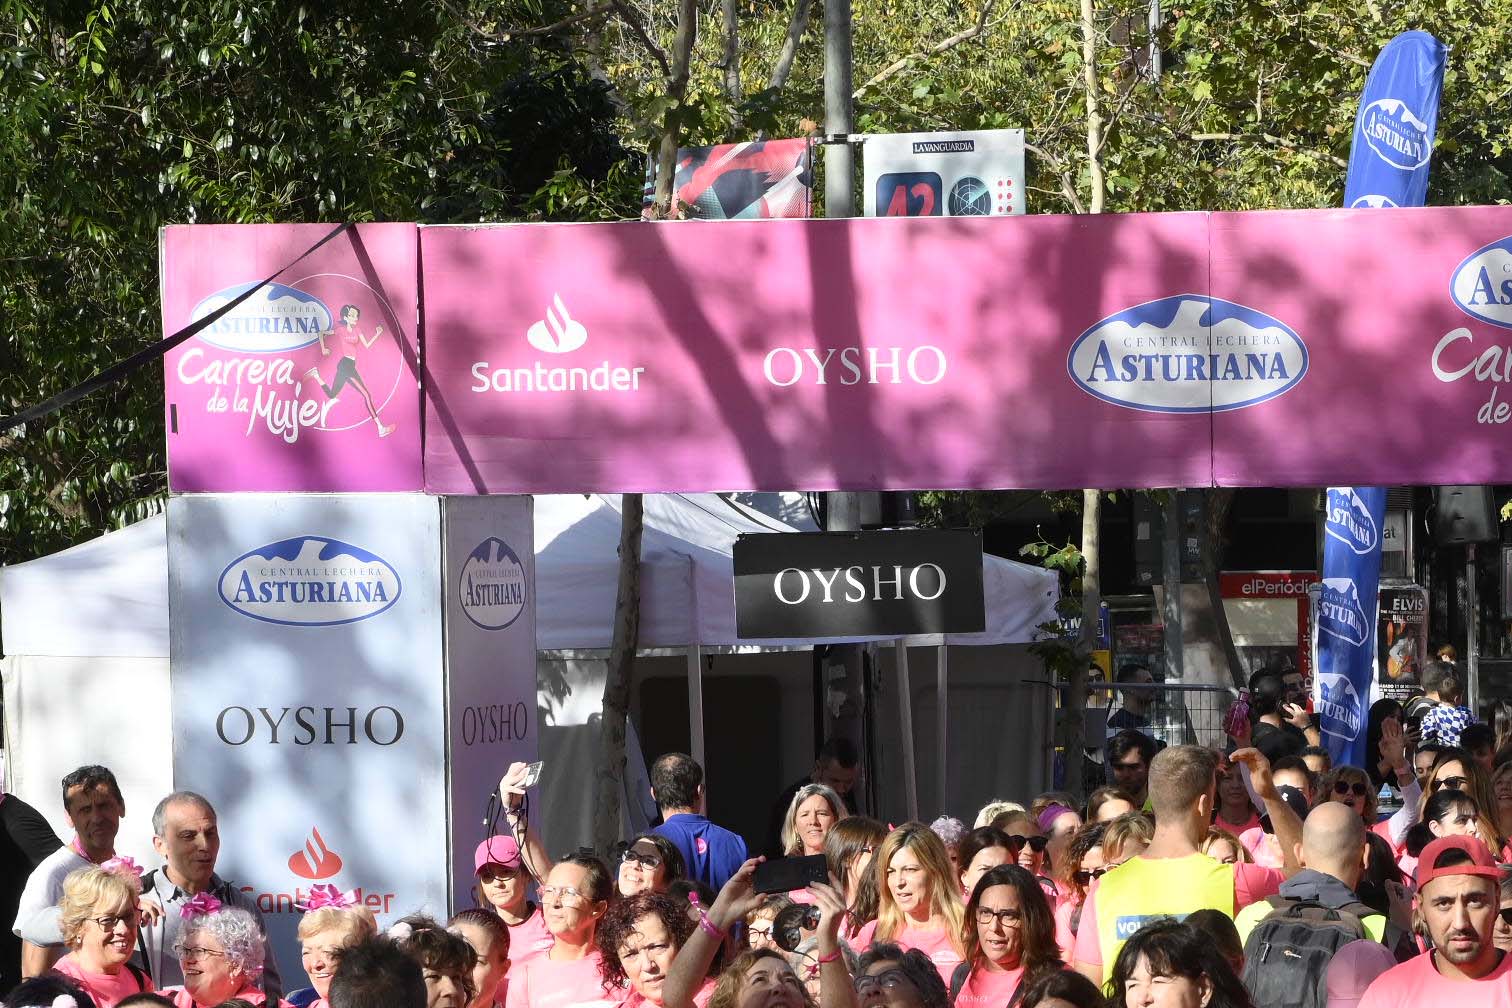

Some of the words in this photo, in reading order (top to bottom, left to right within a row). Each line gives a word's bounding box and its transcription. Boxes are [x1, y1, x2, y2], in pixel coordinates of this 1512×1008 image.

[1122, 335, 1199, 348] CENTRAL
[1205, 334, 1281, 346] LECHERA
[177, 346, 296, 385] Carrera
[471, 361, 645, 393] Santander
[762, 345, 947, 387] OYSHO
[1086, 339, 1290, 382] ASTURIANA
[207, 387, 228, 412] de
[233, 387, 249, 413] la
[246, 384, 341, 443] Mujer
[1477, 386, 1512, 424] de
[233, 570, 388, 603] ASTURIANA
[260, 567, 318, 577] CENTRAL
[324, 567, 383, 577] LECHERA
[465, 571, 523, 607] ASTURIANA
[773, 563, 947, 605] OYSHO
[1242, 580, 1311, 596] elPeriódi
[1393, 598, 1424, 611] ELVIS
[216, 706, 404, 745] OYSHO
[462, 702, 528, 746] OYSHO
